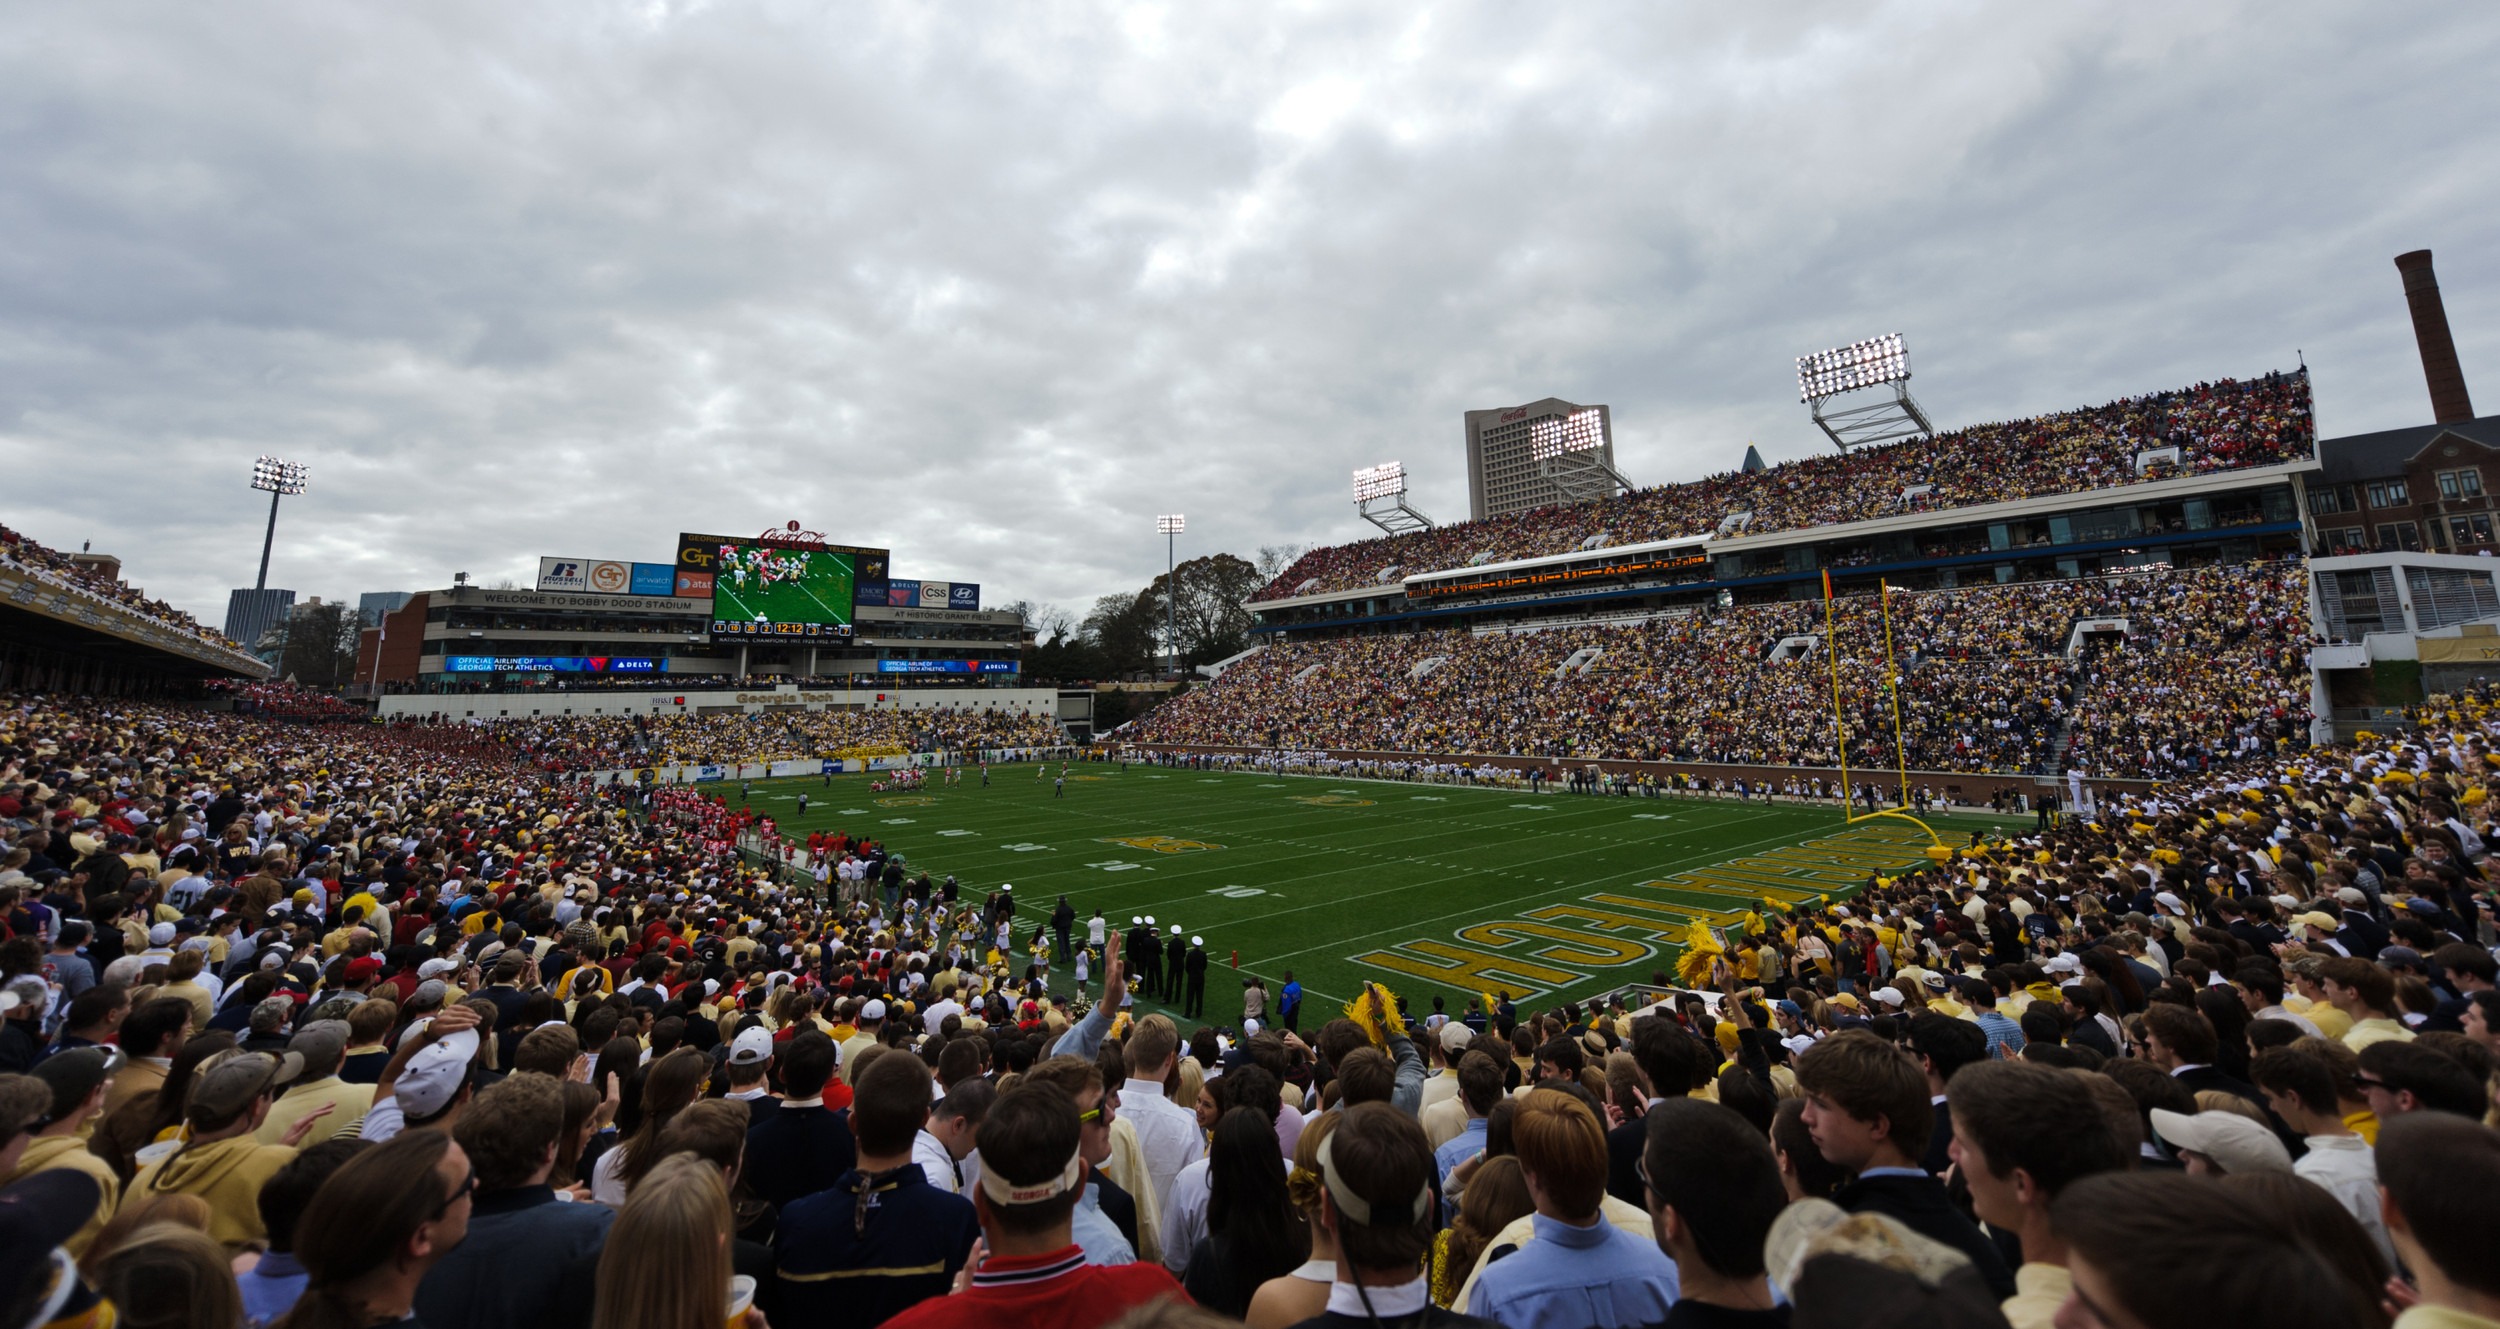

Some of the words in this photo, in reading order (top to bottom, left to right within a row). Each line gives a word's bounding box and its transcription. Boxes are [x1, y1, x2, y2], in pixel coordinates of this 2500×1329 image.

[688, 534, 726, 544] GEORGIA
[727, 537, 749, 545] TECH
[828, 545, 858, 555] YELLOW
[858, 548, 889, 556] JACKETS
[681, 548, 714, 567] GT
[543, 575, 583, 583] RUSSELL
[636, 576, 671, 584] airwatch
[692, 579, 712, 589] at&t
[860, 587, 884, 595] EMORY
[925, 588, 947, 598] CSS
[485, 594, 546, 605] WELCOME
[551, 596, 566, 605] TO
[570, 597, 608, 607] BOBBY
[611, 599, 642, 608] DODD
[645, 601, 692, 610] STADIUM
[776, 624, 802, 633] 12:12
[736, 693, 797, 704] Georgia
[801, 692, 834, 703] Tech
[1012, 1188, 1051, 1200] GEORGIA
